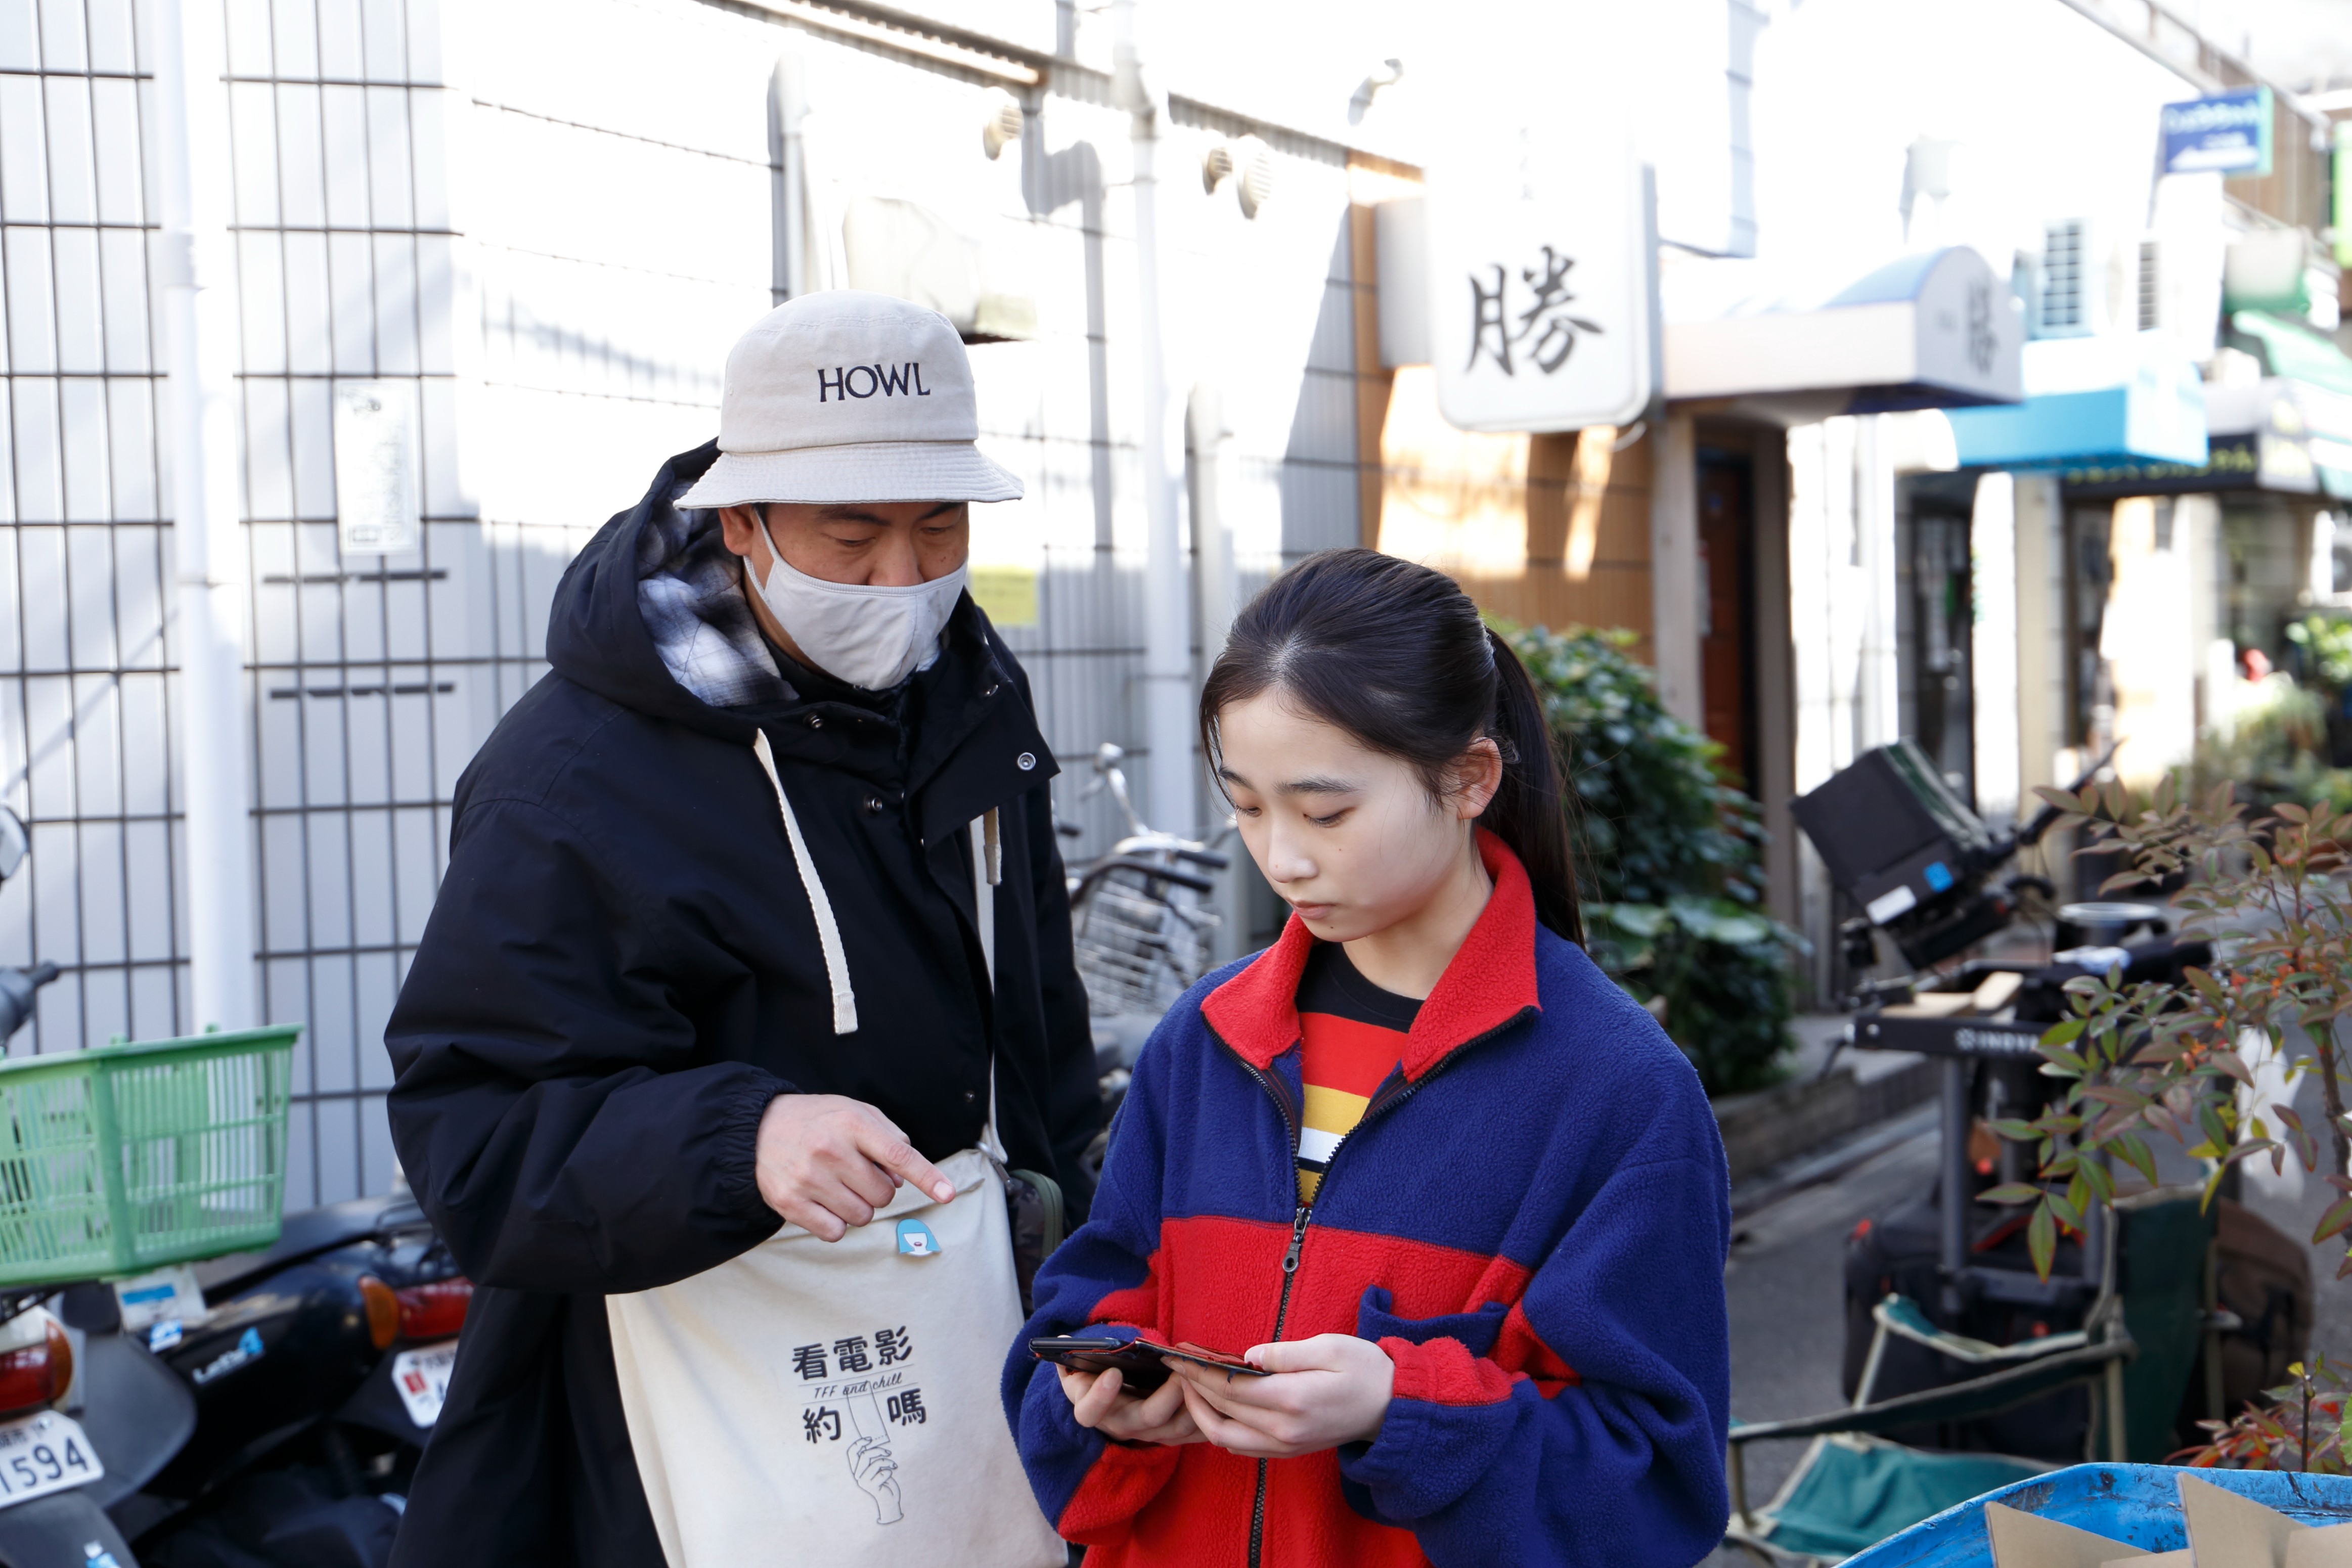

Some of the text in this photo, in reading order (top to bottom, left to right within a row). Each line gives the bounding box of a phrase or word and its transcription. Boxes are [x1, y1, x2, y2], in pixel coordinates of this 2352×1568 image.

[1462, 245, 1605, 376] 勝
[817, 363, 931, 402] HOWL
[792, 1325, 913, 1380] 看電影
[814, 1372, 903, 1399] TFF and chill
[803, 1387, 927, 1444] 約 嗎
